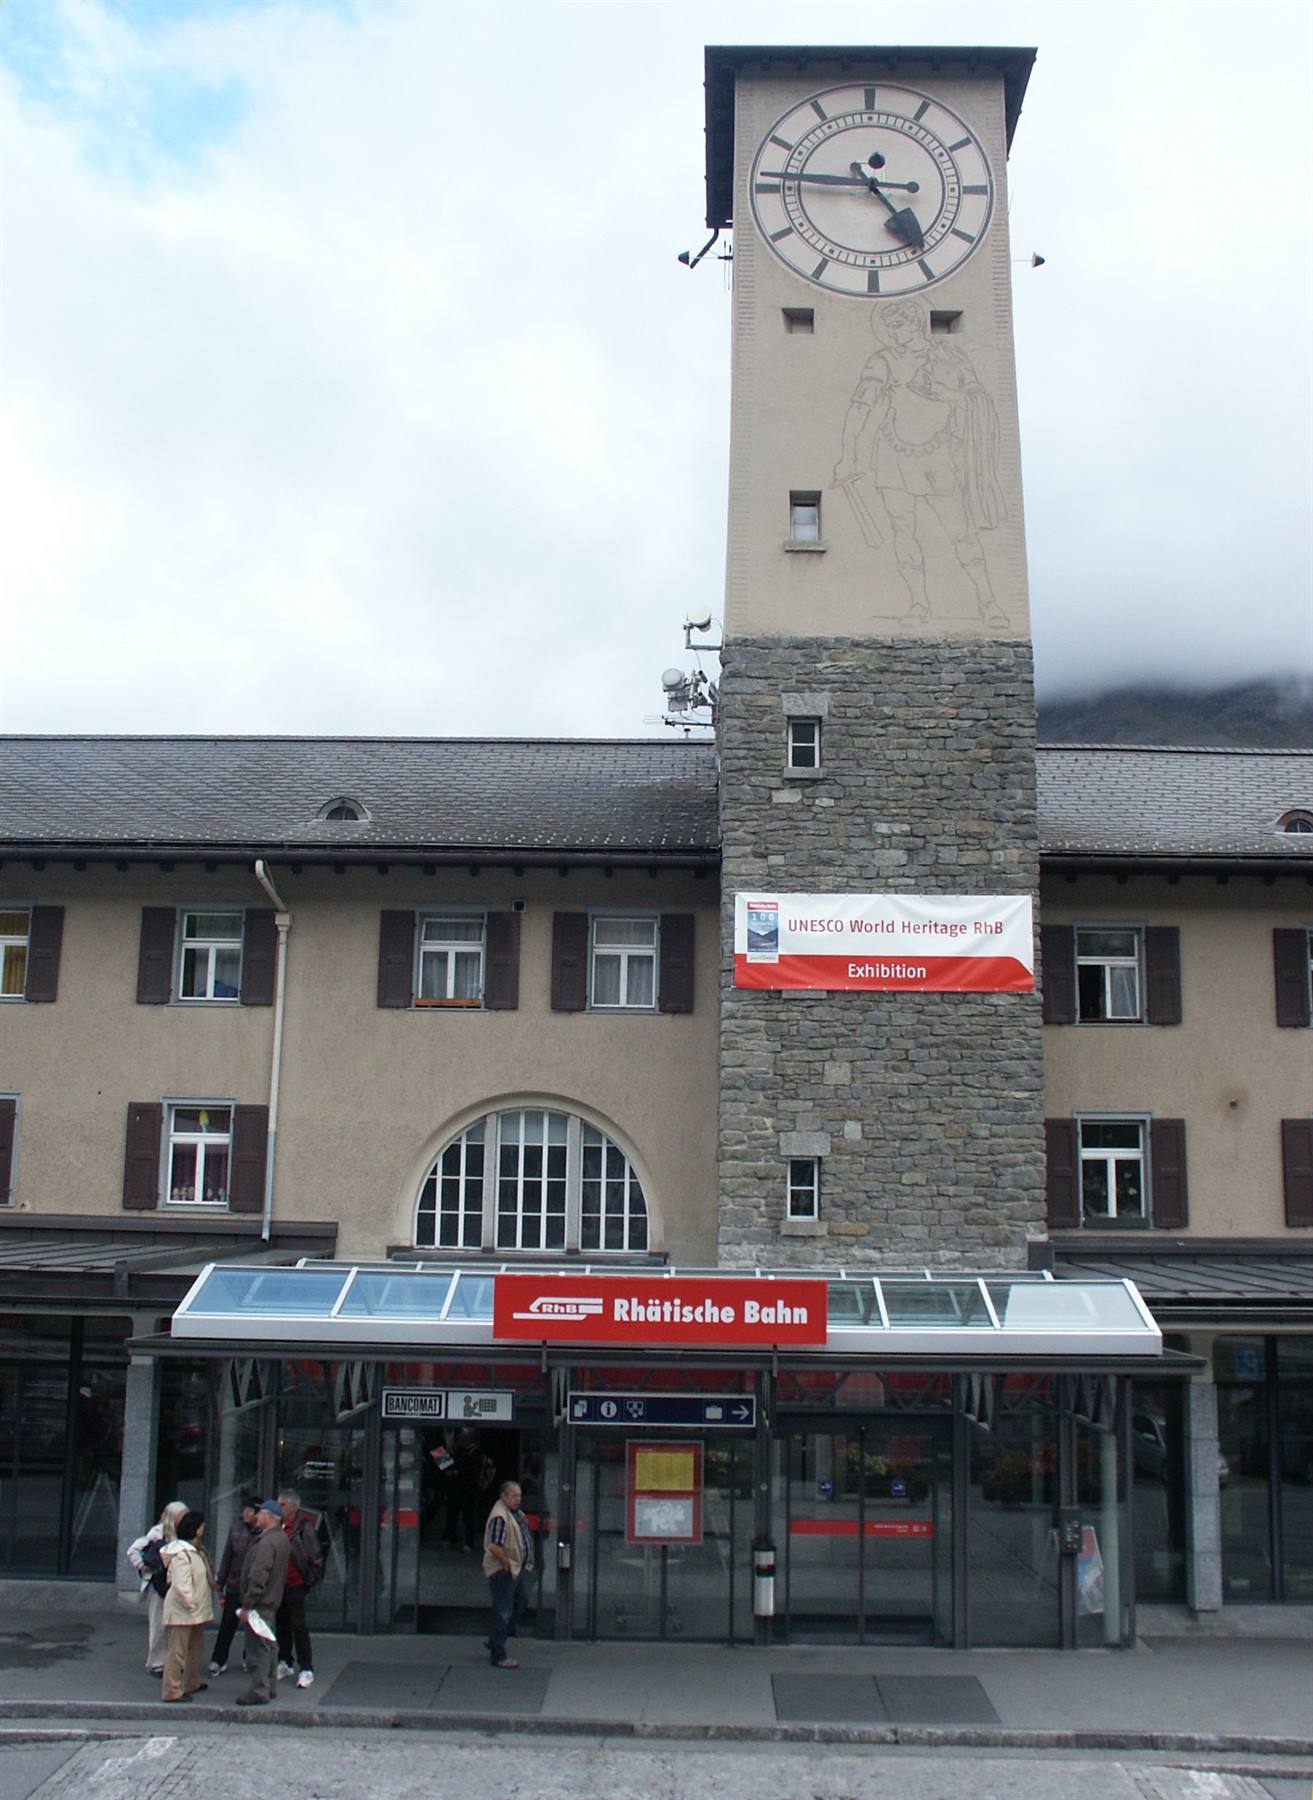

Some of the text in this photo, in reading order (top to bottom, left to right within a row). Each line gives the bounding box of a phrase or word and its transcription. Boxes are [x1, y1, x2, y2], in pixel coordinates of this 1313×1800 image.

[788, 919, 844, 933] UNESCO
[850, 919, 895, 934] World
[902, 921, 967, 938] Heritage
[974, 921, 1004, 935] RhB
[848, 963, 927, 979] Exhibition
[541, 1297, 808, 1324] RhB Rhätische Bahn
[388, 1396, 439, 1413] BANCOMAT
